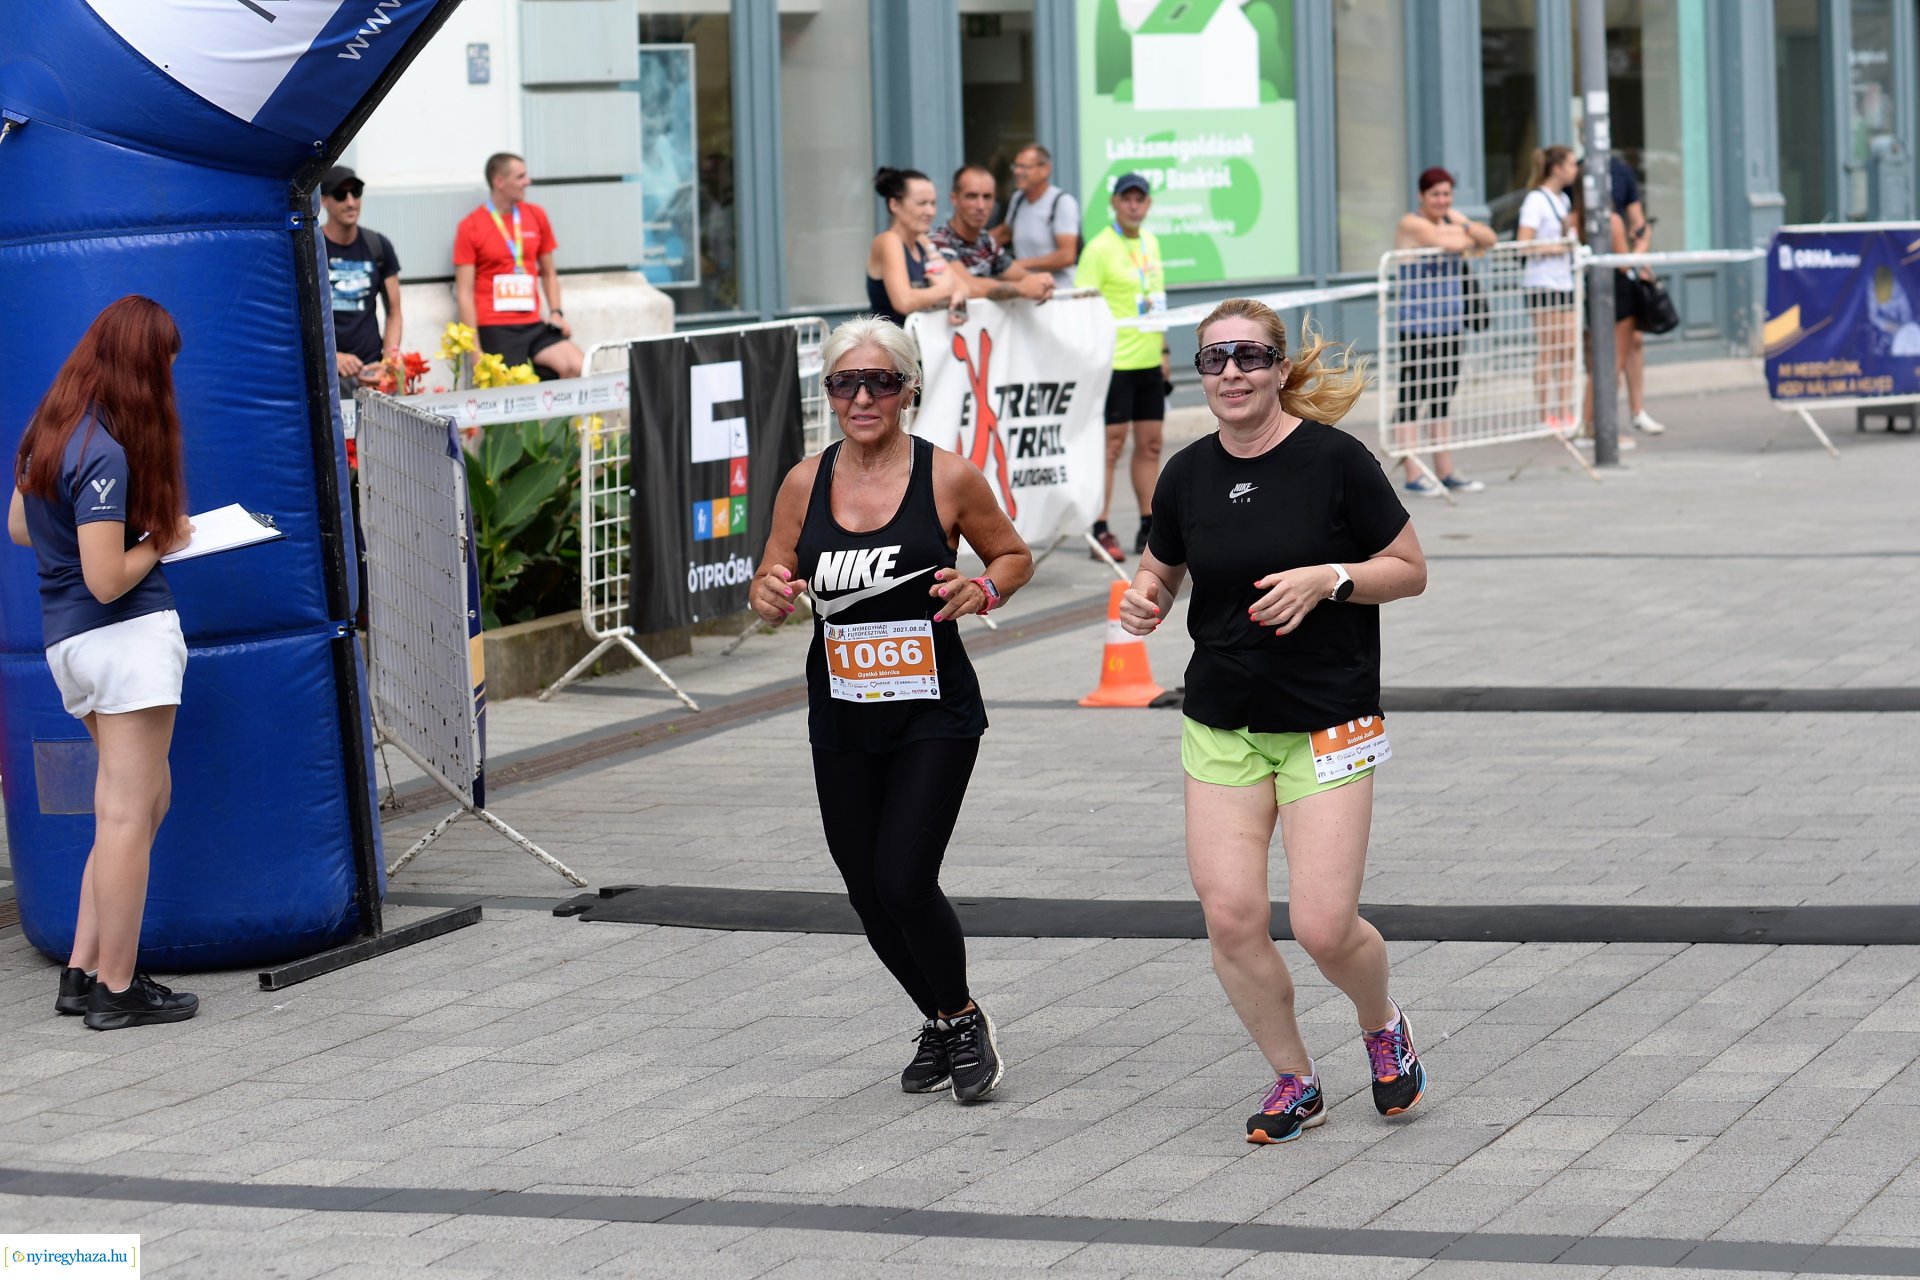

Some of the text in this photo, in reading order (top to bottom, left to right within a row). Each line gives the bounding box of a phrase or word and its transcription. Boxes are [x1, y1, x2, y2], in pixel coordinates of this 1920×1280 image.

[1106, 134, 1254, 163] Lakásmegoldások
[1167, 165, 1232, 190] Banktól
[1007, 424, 1066, 460] TRAIL
[1233, 482, 1252, 493] NIKE
[687, 553, 754, 594] ÖTPRÓBA
[813, 544, 902, 592] NIKE
[834, 639, 923, 669] 1066
[879, 669, 900, 677] Mónika
